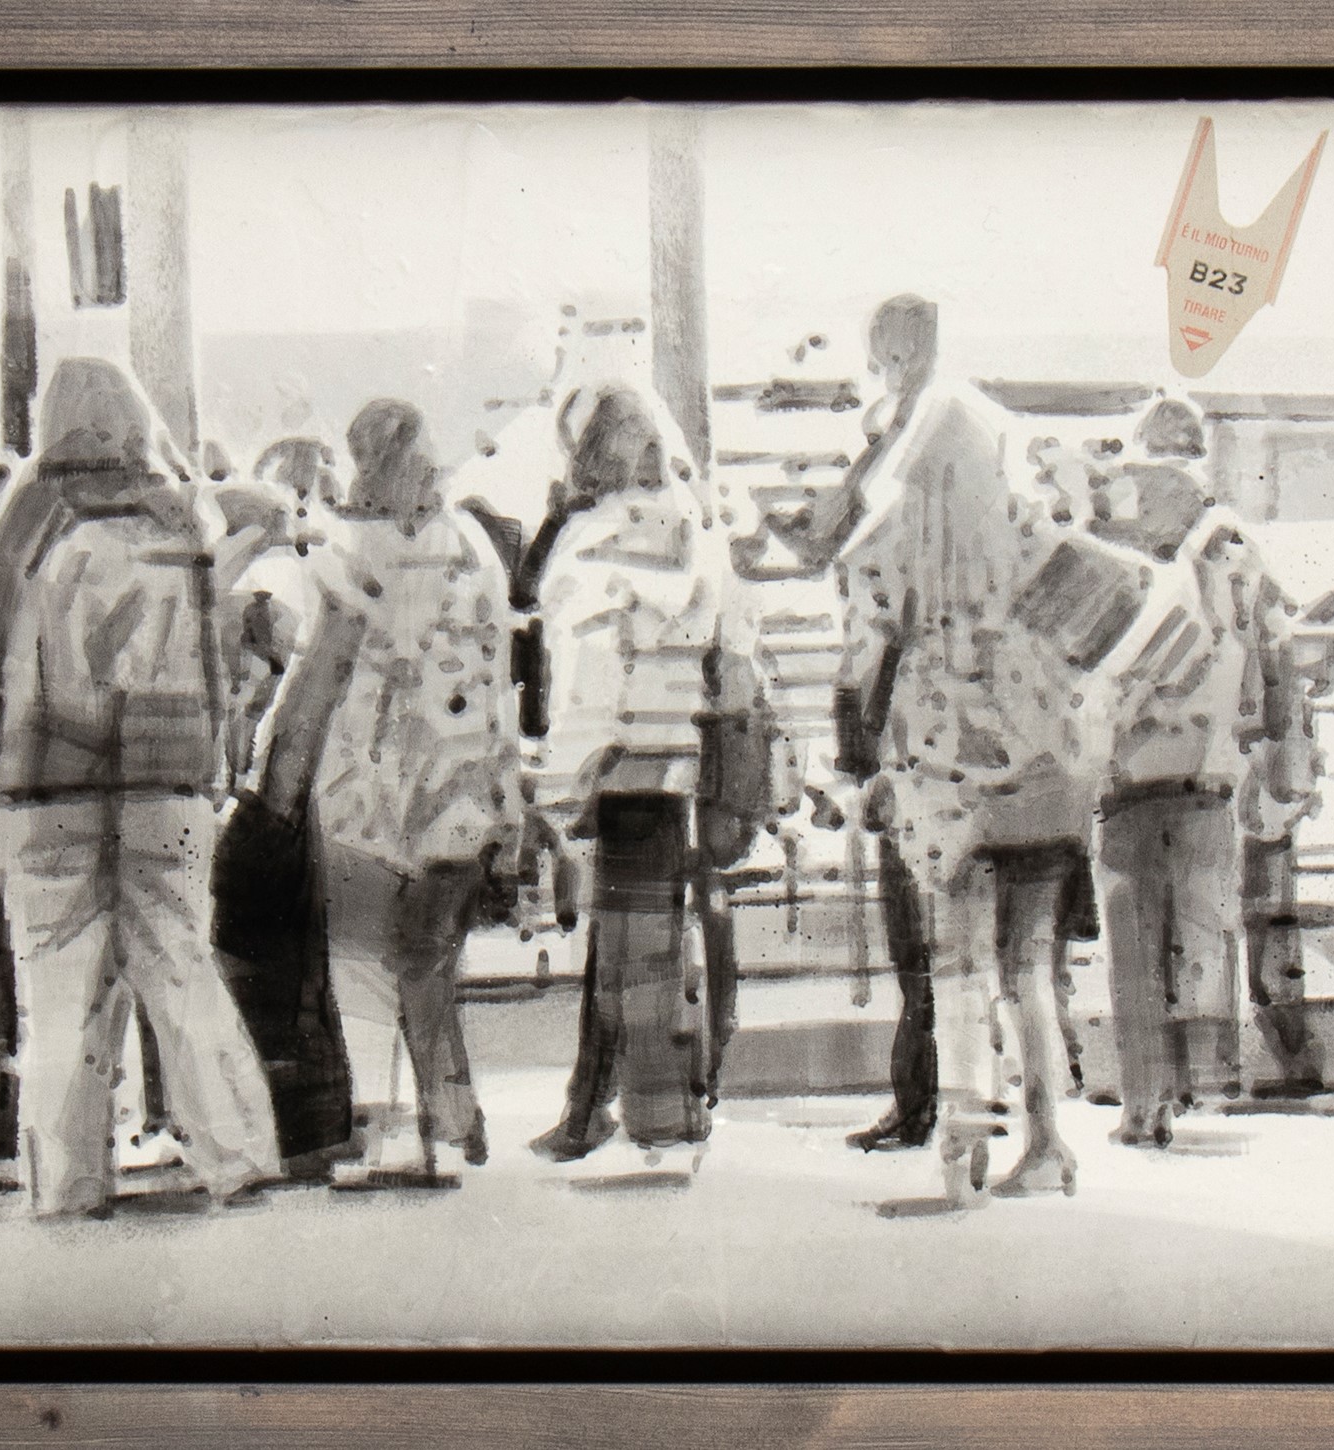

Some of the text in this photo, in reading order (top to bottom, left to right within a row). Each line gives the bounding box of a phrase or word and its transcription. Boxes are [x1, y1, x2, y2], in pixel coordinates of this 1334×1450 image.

[1191, 227, 1200, 242] IL
[1204, 232, 1227, 250] MIO
[1231, 238, 1269, 263] TURNO
[1189, 259, 1248, 295] B23
[1183, 299, 1227, 323] TIRARE
